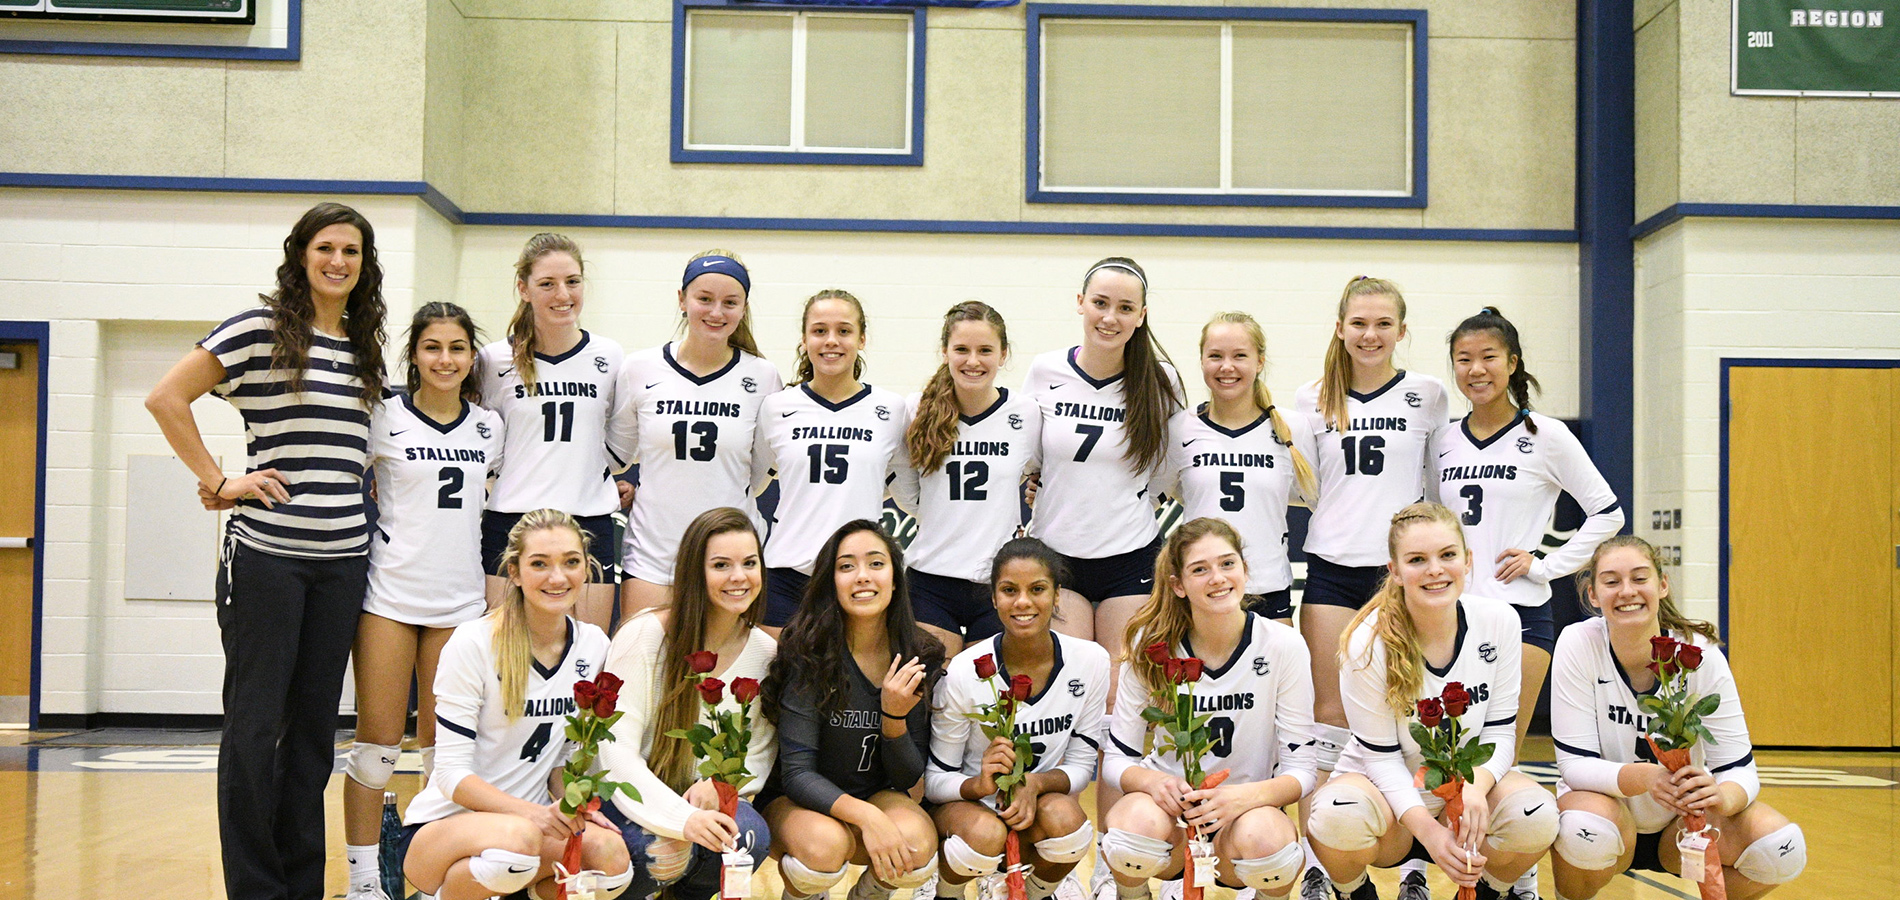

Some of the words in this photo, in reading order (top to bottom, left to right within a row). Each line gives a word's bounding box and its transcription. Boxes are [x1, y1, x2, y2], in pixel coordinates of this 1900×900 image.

[1790, 9, 1884, 27] REGION
[1747, 31, 1774, 48] 2011
[515, 382, 597, 398] SALLIONS
[655, 400, 741, 418] STALLIONS
[1054, 402, 1127, 422] STALLION
[541, 401, 574, 442] 11
[671, 420, 718, 462] 13
[791, 426, 874, 442] STALLIONS
[1072, 423, 1104, 463] 7
[405, 447, 486, 464] STALLIONS
[950, 441, 1010, 457] LLIONS
[1341, 435, 1386, 476] 16
[807, 443, 850, 485] 15
[1192, 453, 1275, 469] STALLIONS
[946, 461, 989, 501] 12
[1441, 464, 1518, 482] STALLIONS
[437, 466, 465, 509] 2
[1219, 471, 1245, 512] 5
[1459, 484, 1484, 526] 3
[523, 697, 577, 717] ALLION
[829, 709, 882, 729] STALL
[519, 722, 554, 763] 4
[857, 733, 879, 772] 1
